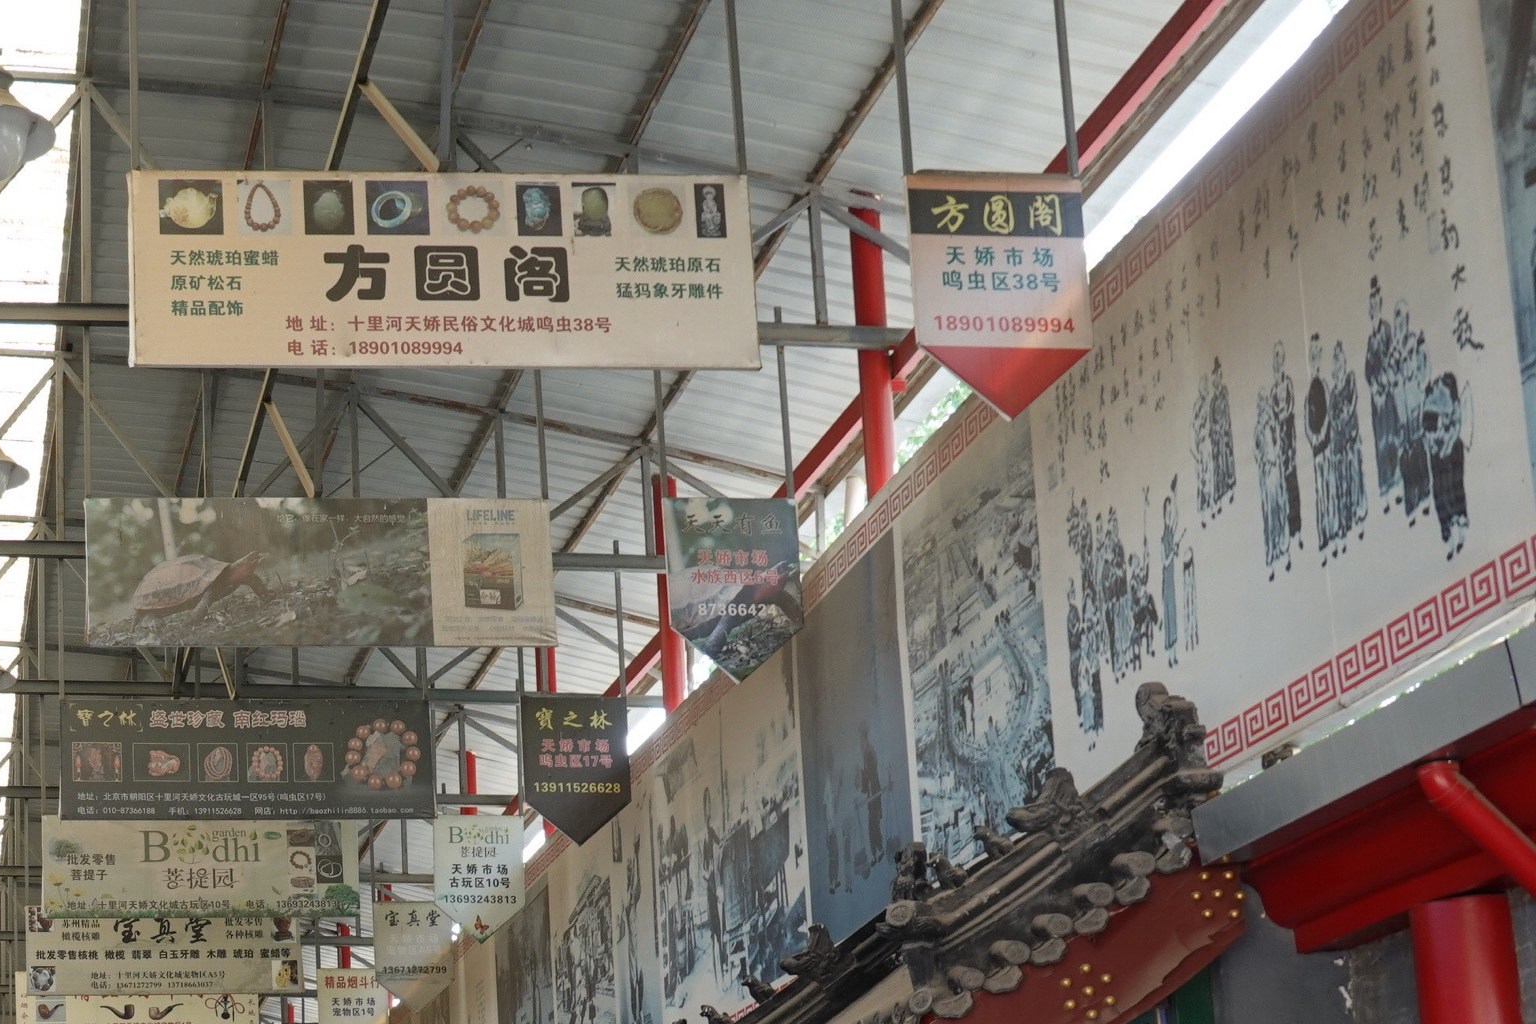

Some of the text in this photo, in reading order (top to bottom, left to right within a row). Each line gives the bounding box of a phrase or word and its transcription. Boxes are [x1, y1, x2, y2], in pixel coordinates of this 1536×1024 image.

[931, 193, 1064, 236] 方圆阁
[170, 249, 280, 268] 天然琥珀蜜蜡
[614, 256, 722, 274] 天然琥珀原石
[945, 246, 1054, 268] 天娇市场
[323, 244, 571, 303] 方圆阁
[942, 270, 1060, 293] 鸣虫区38号
[170, 275, 242, 292] 原矿松石
[615, 281, 725, 301] 猛犸象牙雕件
[170, 300, 244, 318] 精品配饰
[934, 315, 1075, 334] 18901089994
[467, 509, 515, 521] LIFELINE
[682, 512, 782, 535] 天天有鱼
[697, 549, 768, 567] 天娇市场
[698, 603, 777, 616] 87366424
[149, 710, 226, 729] 盛世珍藏
[233, 710, 307, 729] 南红玛瑙
[541, 738, 610, 753] 天娇市场
[538, 754, 613, 769] 鸣虫区17号
[534, 782, 621, 793] 13911526628
[212, 828, 247, 840] garden
[66, 853, 116, 866] 批发零售
[70, 868, 108, 881] 菩提子
[452, 863, 508, 875] 天娇市场
[163, 867, 240, 890] 菩提园
[449, 877, 511, 889] 古玩区10号
[443, 895, 517, 904] 13693243813
[233, 949, 253, 959] 琥珀
[382, 965, 447, 975] 13671272799
[331, 997, 376, 1007] 天娇市场
